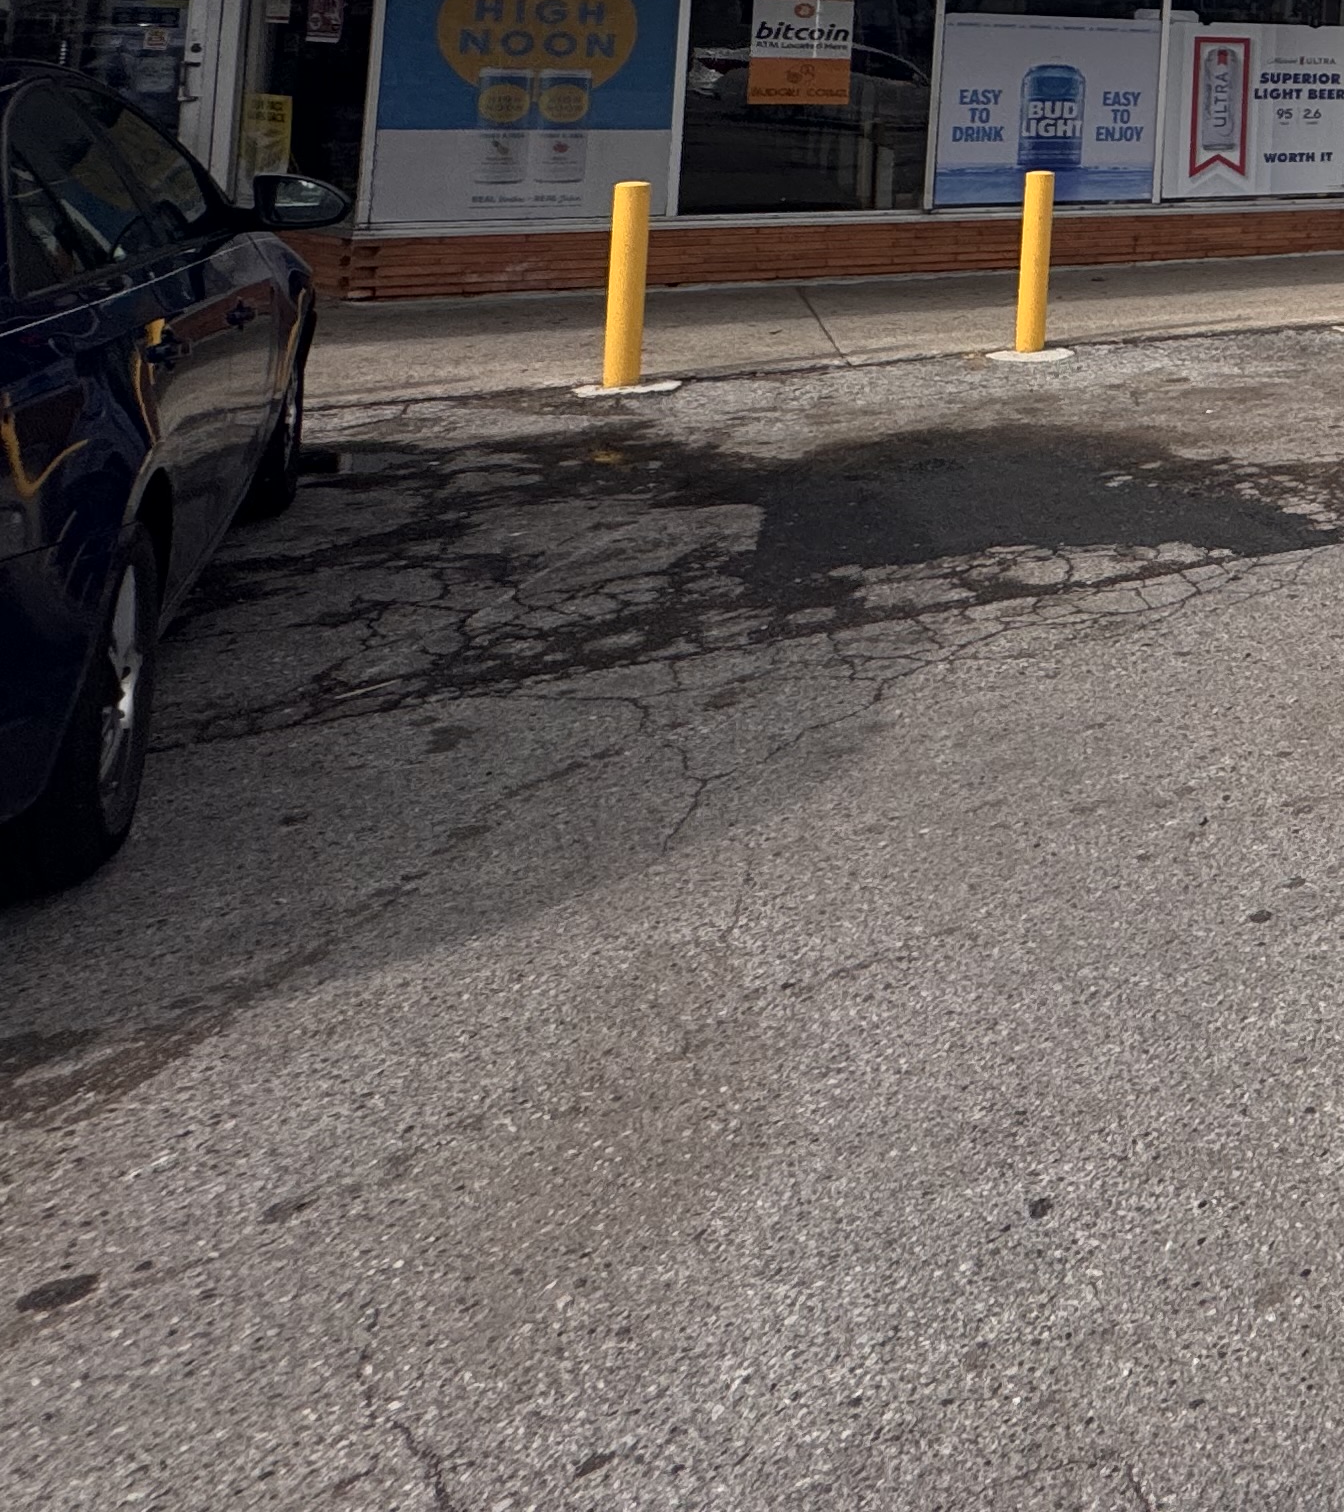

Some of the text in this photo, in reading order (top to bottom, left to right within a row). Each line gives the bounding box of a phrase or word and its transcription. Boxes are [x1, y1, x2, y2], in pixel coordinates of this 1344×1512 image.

[756, 21, 849, 41] bitcoin
[460, 30, 616, 58] NOON
[1306, 57, 1337, 65] ULTRA
[1259, 72, 1341, 85] SUPERIOR
[959, 89, 1003, 105] EASY
[1103, 91, 1141, 106] EASY
[1213, 72, 1229, 128] ULTRA
[1254, 88, 1344, 100] LIGHT BEER
[969, 107, 990, 123] TO
[1028, 101, 1079, 118] BUD
[1111, 109, 1131, 124] TO
[1276, 108, 1293, 119] 95
[952, 126, 1005, 142] DRINK
[1021, 119, 1083, 137] LIGHT
[1095, 126, 1144, 142] ENJOY
[1264, 152, 1333, 163] WORTH IT
